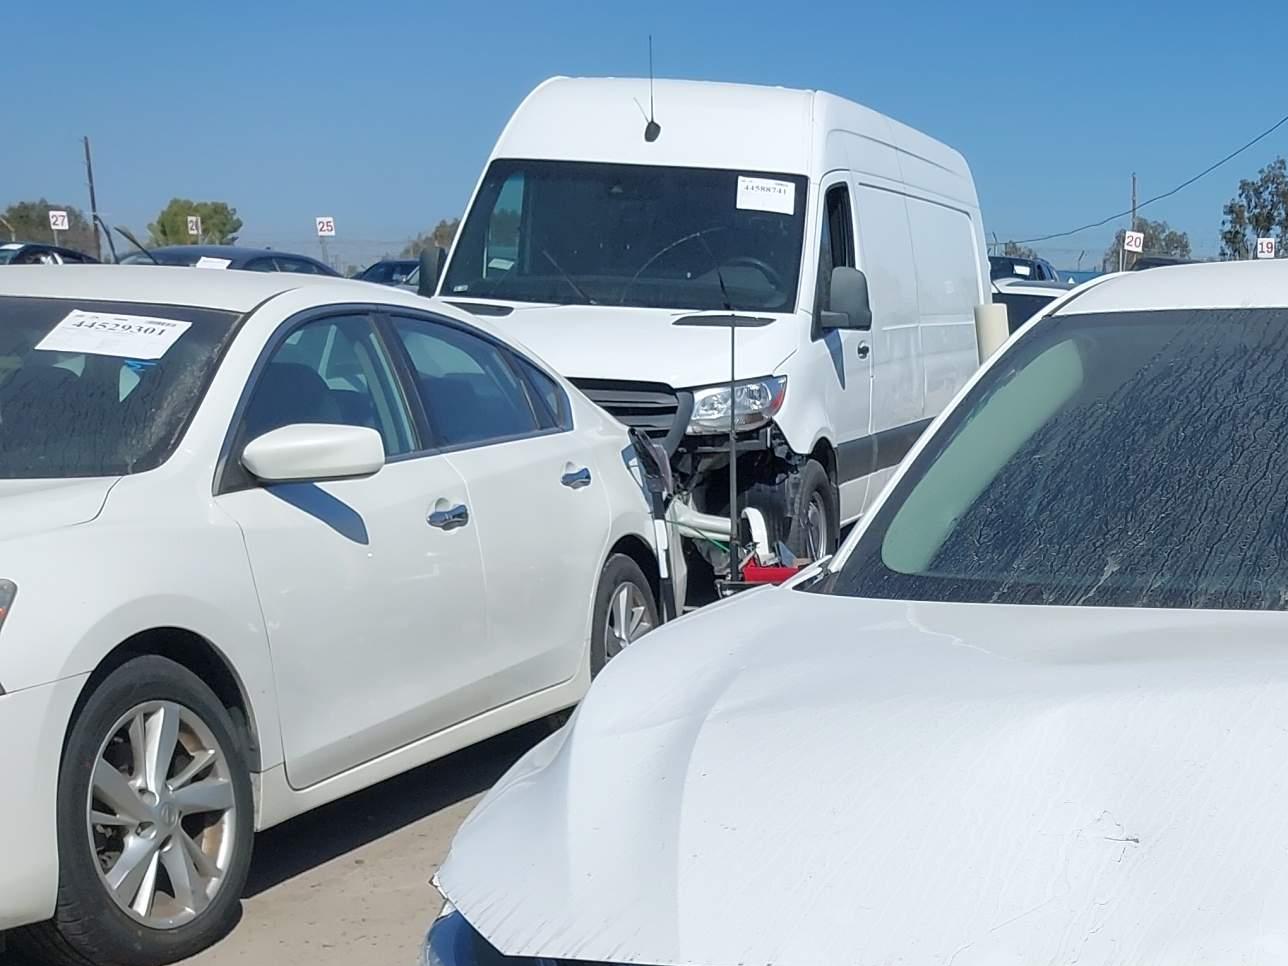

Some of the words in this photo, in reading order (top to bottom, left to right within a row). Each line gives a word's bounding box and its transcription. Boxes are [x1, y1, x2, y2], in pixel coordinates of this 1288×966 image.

[51, 214, 66, 227] 27
[317, 220, 333, 233] 25
[1126, 235, 1142, 249] 20
[1258, 241, 1274, 254] 19
[71, 319, 167, 337] 44529301
